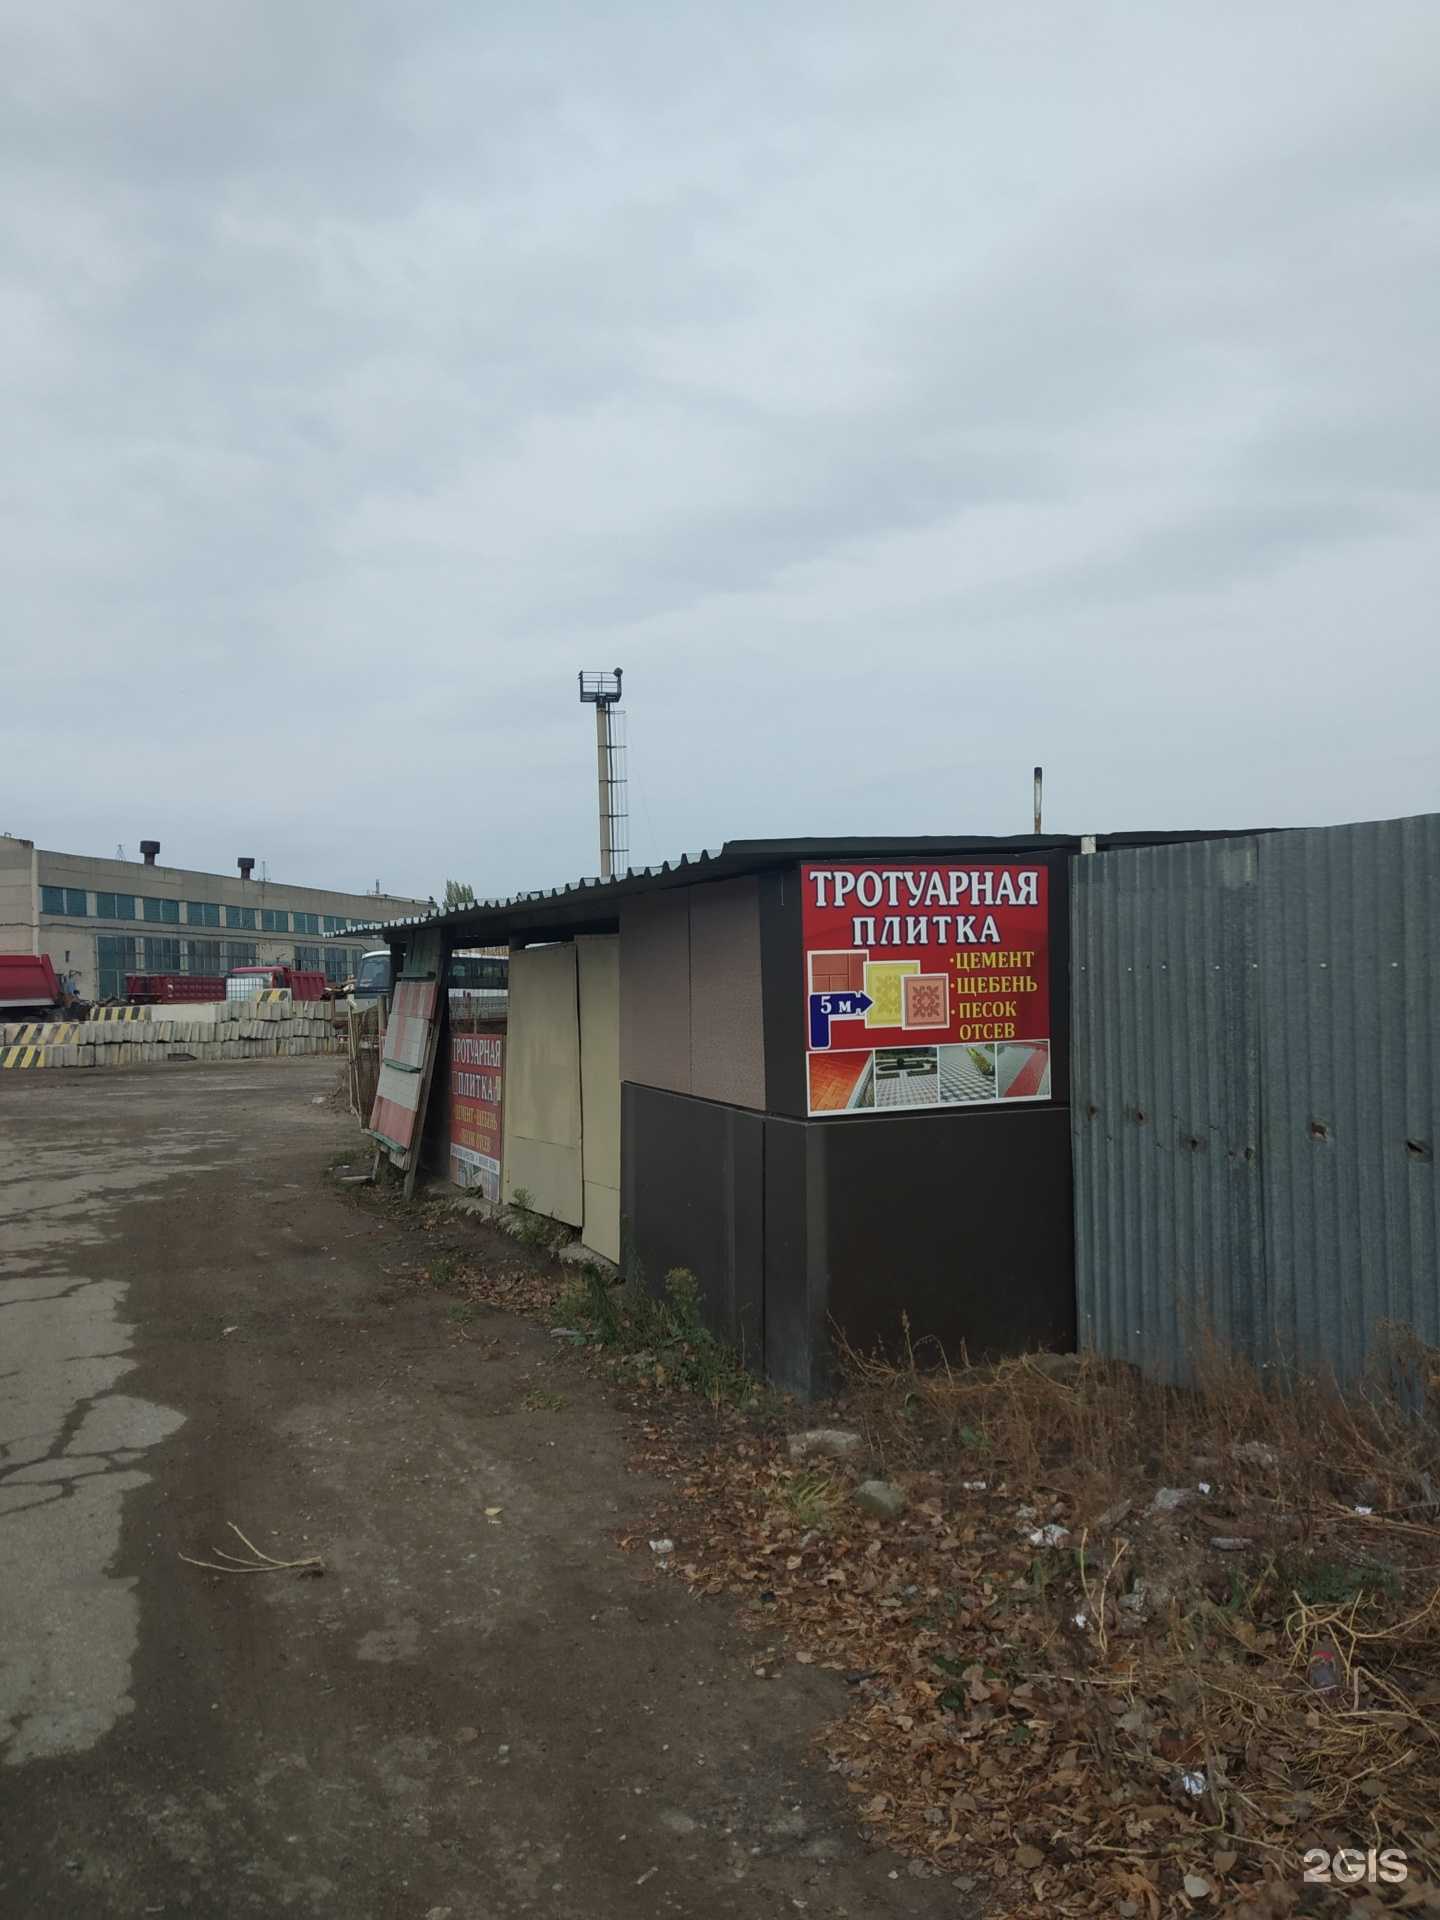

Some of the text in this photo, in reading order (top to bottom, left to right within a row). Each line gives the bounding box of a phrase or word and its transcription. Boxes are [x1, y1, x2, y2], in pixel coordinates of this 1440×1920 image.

[809, 871, 1039, 907] ТРОТУАРНАЯ
[852, 915, 1001, 945] ПЛИТКА
[956, 951, 1035, 971] ЦЕМЕНТ
[956, 975, 1038, 996] ЩЕБЕНЬ
[820, 995, 832, 1014] 5
[959, 1000, 1017, 1019] ПЕСОК
[959, 1022, 1016, 1041] ОТСЕВ
[458, 1071, 493, 1101] ПЛИТКА
